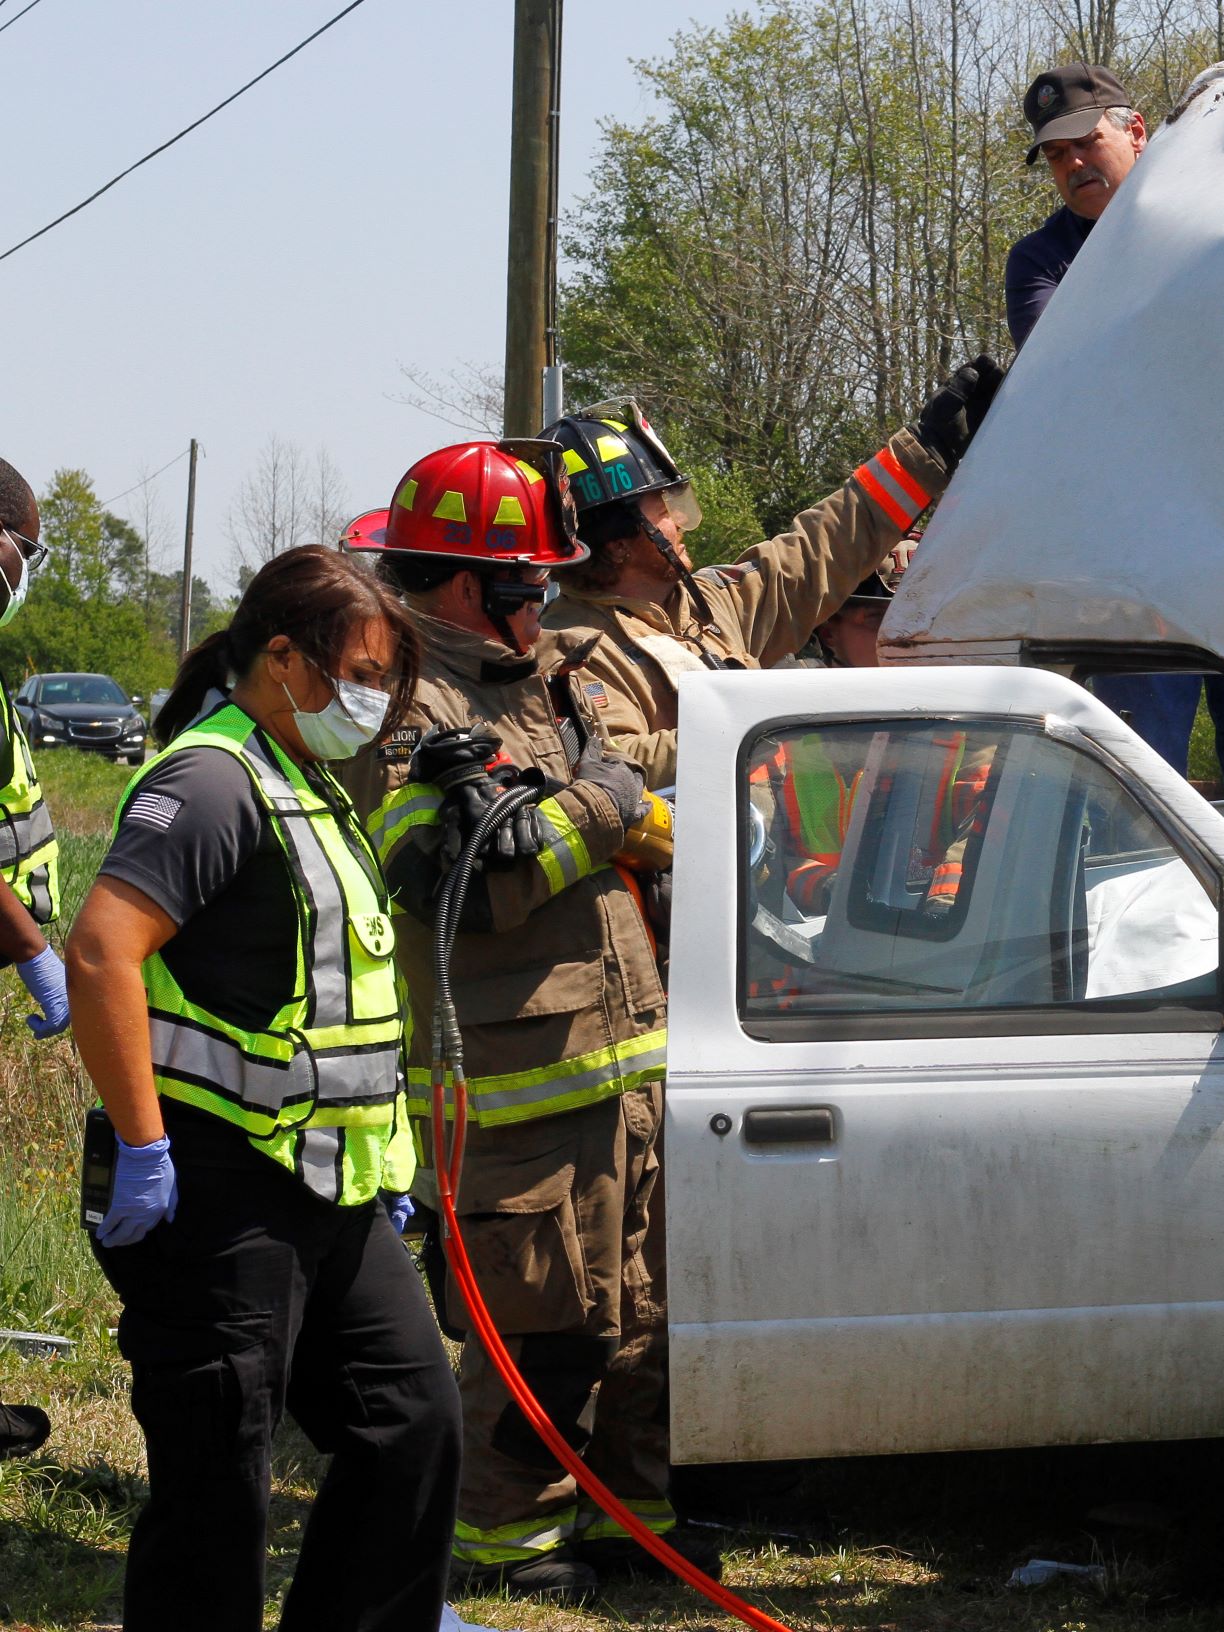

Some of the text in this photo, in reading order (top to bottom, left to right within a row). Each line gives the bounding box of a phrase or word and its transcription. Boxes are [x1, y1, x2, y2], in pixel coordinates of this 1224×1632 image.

[577, 463, 632, 502] 16 76
[444, 523, 516, 549] 23 06
[391, 730, 417, 742] LION
